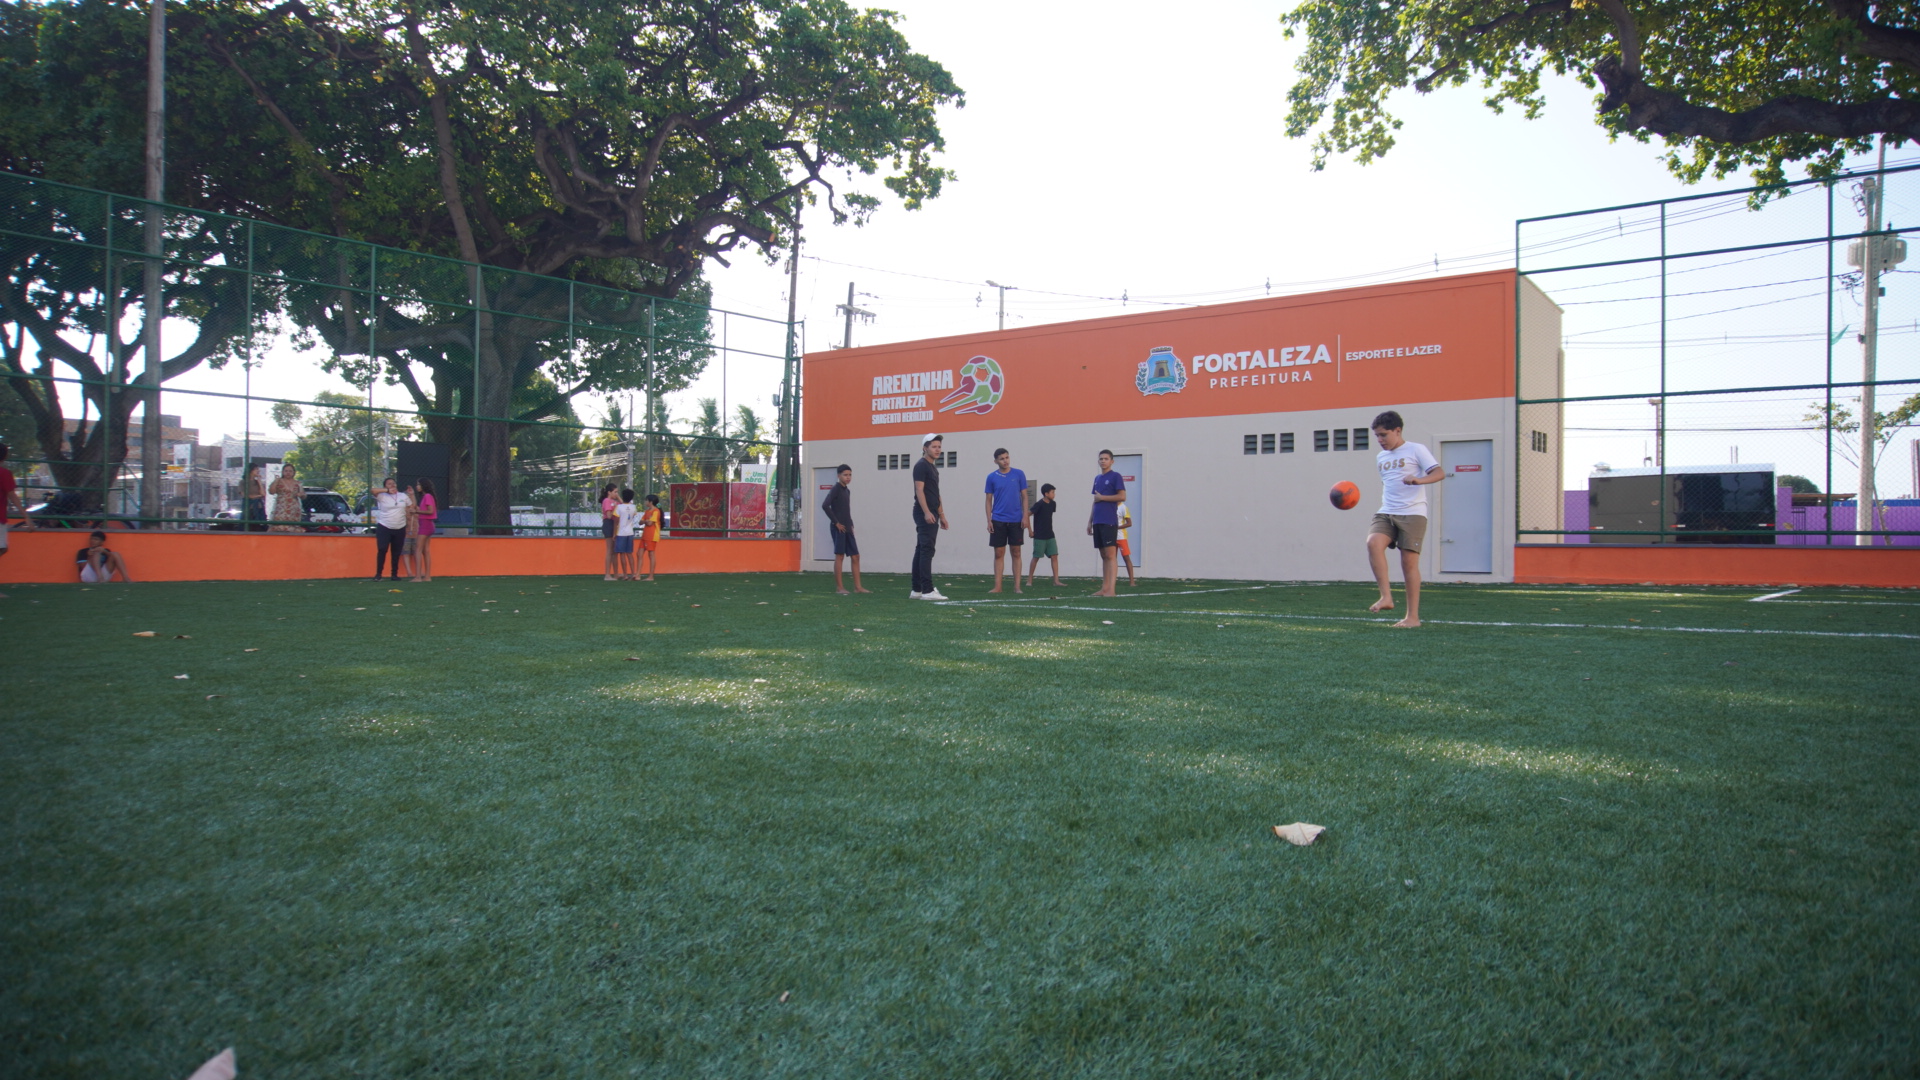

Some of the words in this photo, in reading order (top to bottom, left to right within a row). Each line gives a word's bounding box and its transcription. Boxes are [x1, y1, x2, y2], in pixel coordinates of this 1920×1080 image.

[1192, 344, 1332, 375] FORTALEZA
[1345, 348, 1395, 361] ESPORTE
[1396, 347, 1403, 358] E
[1404, 344, 1442, 356] LAZER
[872, 370, 953, 395] ARENINHA
[1209, 370, 1312, 389] PREFEITURA
[872, 395, 926, 411] FORTALEZA
